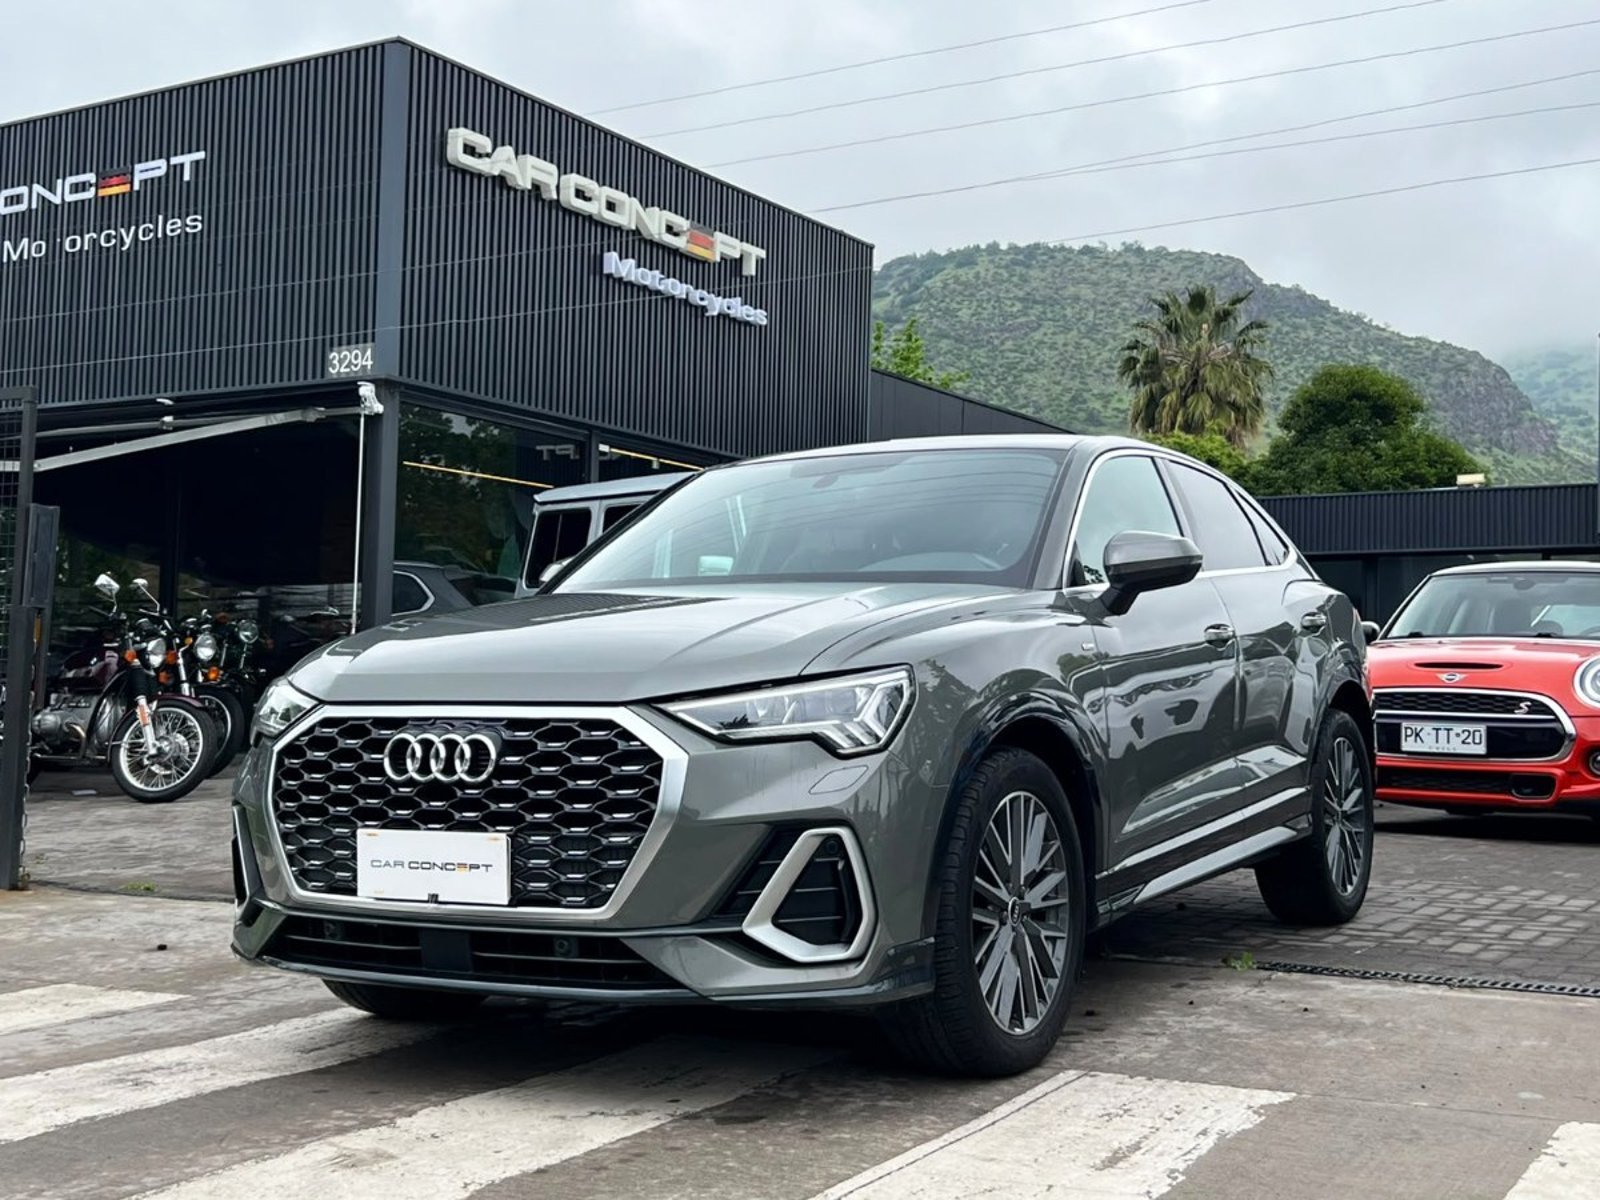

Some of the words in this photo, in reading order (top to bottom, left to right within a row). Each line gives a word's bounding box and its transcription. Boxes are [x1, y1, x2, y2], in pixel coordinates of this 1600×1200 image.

[447, 127, 559, 200] CAR
[3, 215, 202, 263] Moorcycles
[603, 251, 768, 326] Motorcycles
[328, 348, 374, 374] 3294
[370, 859, 405, 869] CAR
